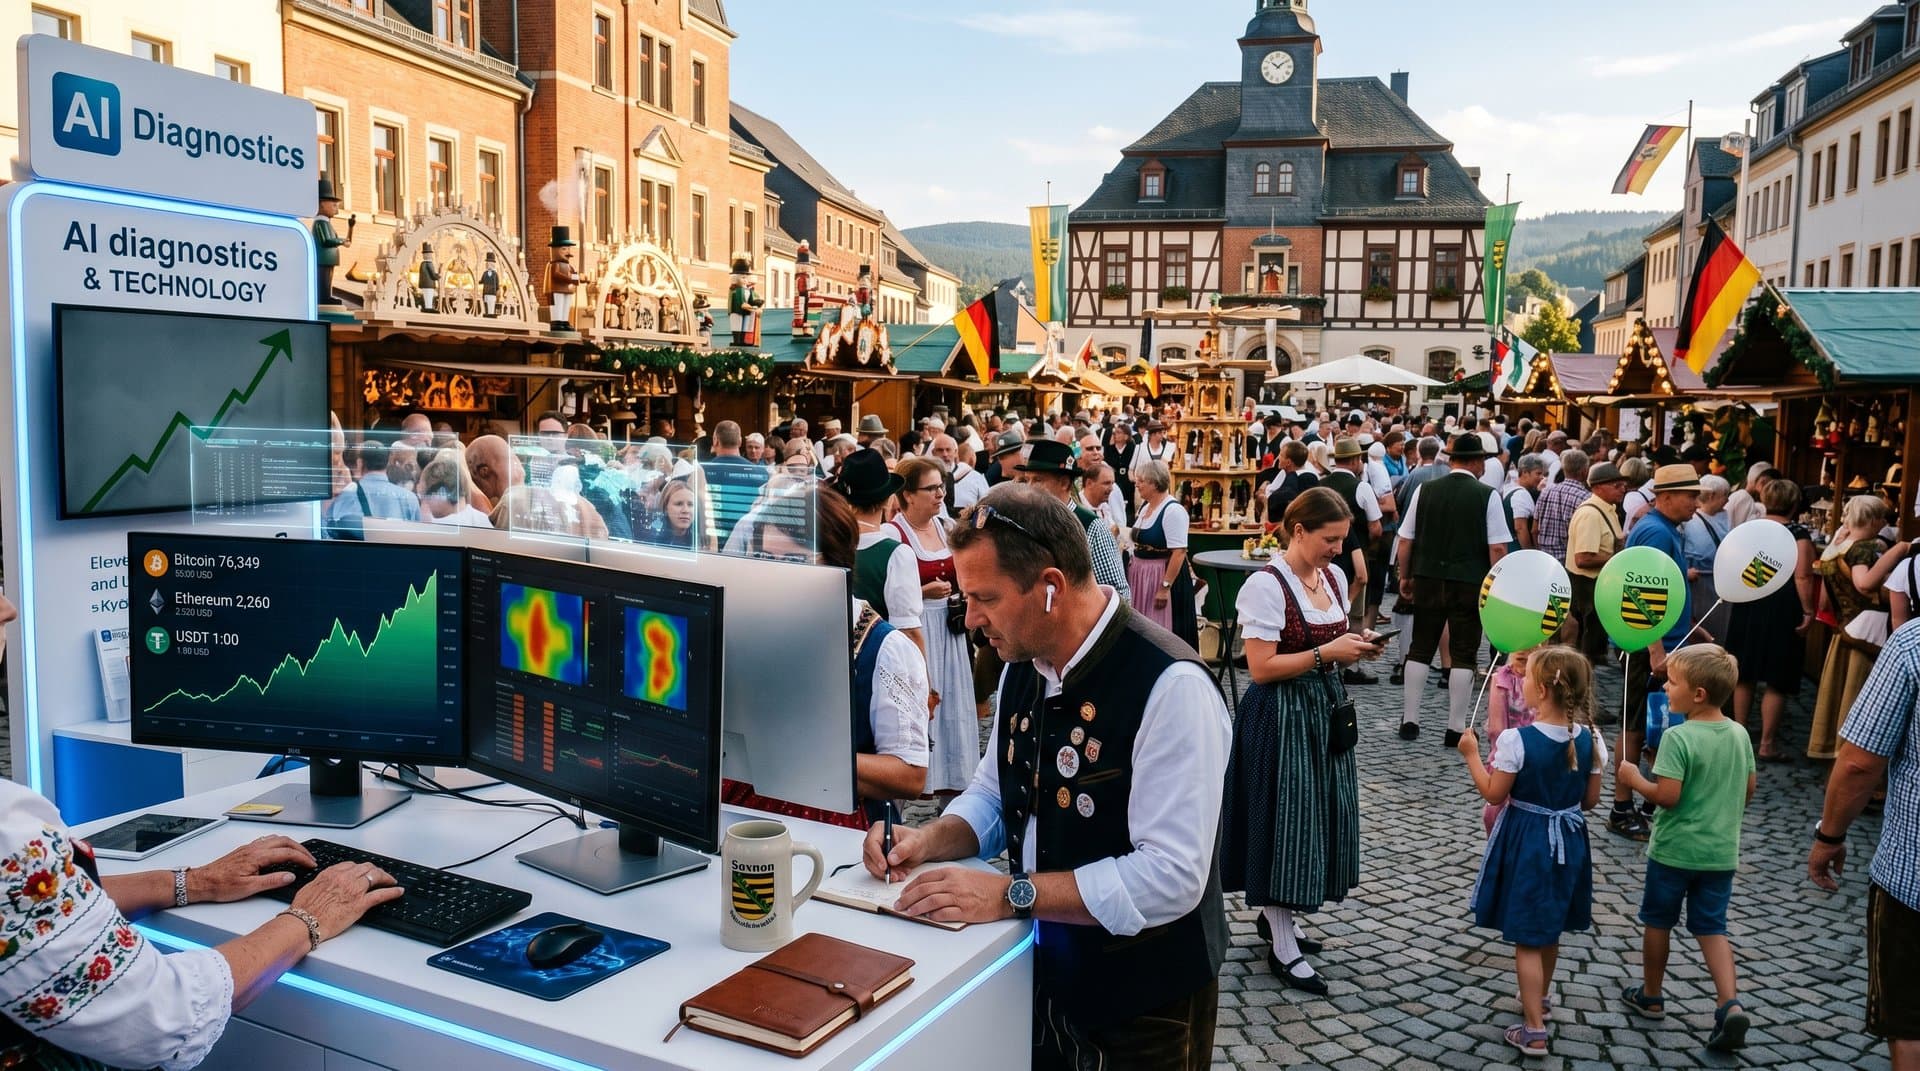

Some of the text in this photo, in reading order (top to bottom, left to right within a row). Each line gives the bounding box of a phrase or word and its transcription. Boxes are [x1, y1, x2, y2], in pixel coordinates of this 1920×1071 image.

[62, 91, 305, 170] AI Diagnostics
[63, 221, 278, 271] AI diagnostics
[83, 267, 267, 303] & TECHNOLOGY
[174, 553, 260, 570] Bitcoin 76,349
[1757, 550, 1783, 569] Saxon
[196, 570, 213, 579] USD
[1624, 571, 1669, 586] Saxon
[91, 575, 118, 591] and
[175, 592, 270, 610] Ethereum 2,260
[196, 608, 213, 617] USD
[176, 630, 239, 646] USDT 1:00
[193, 647, 210, 656] USD
